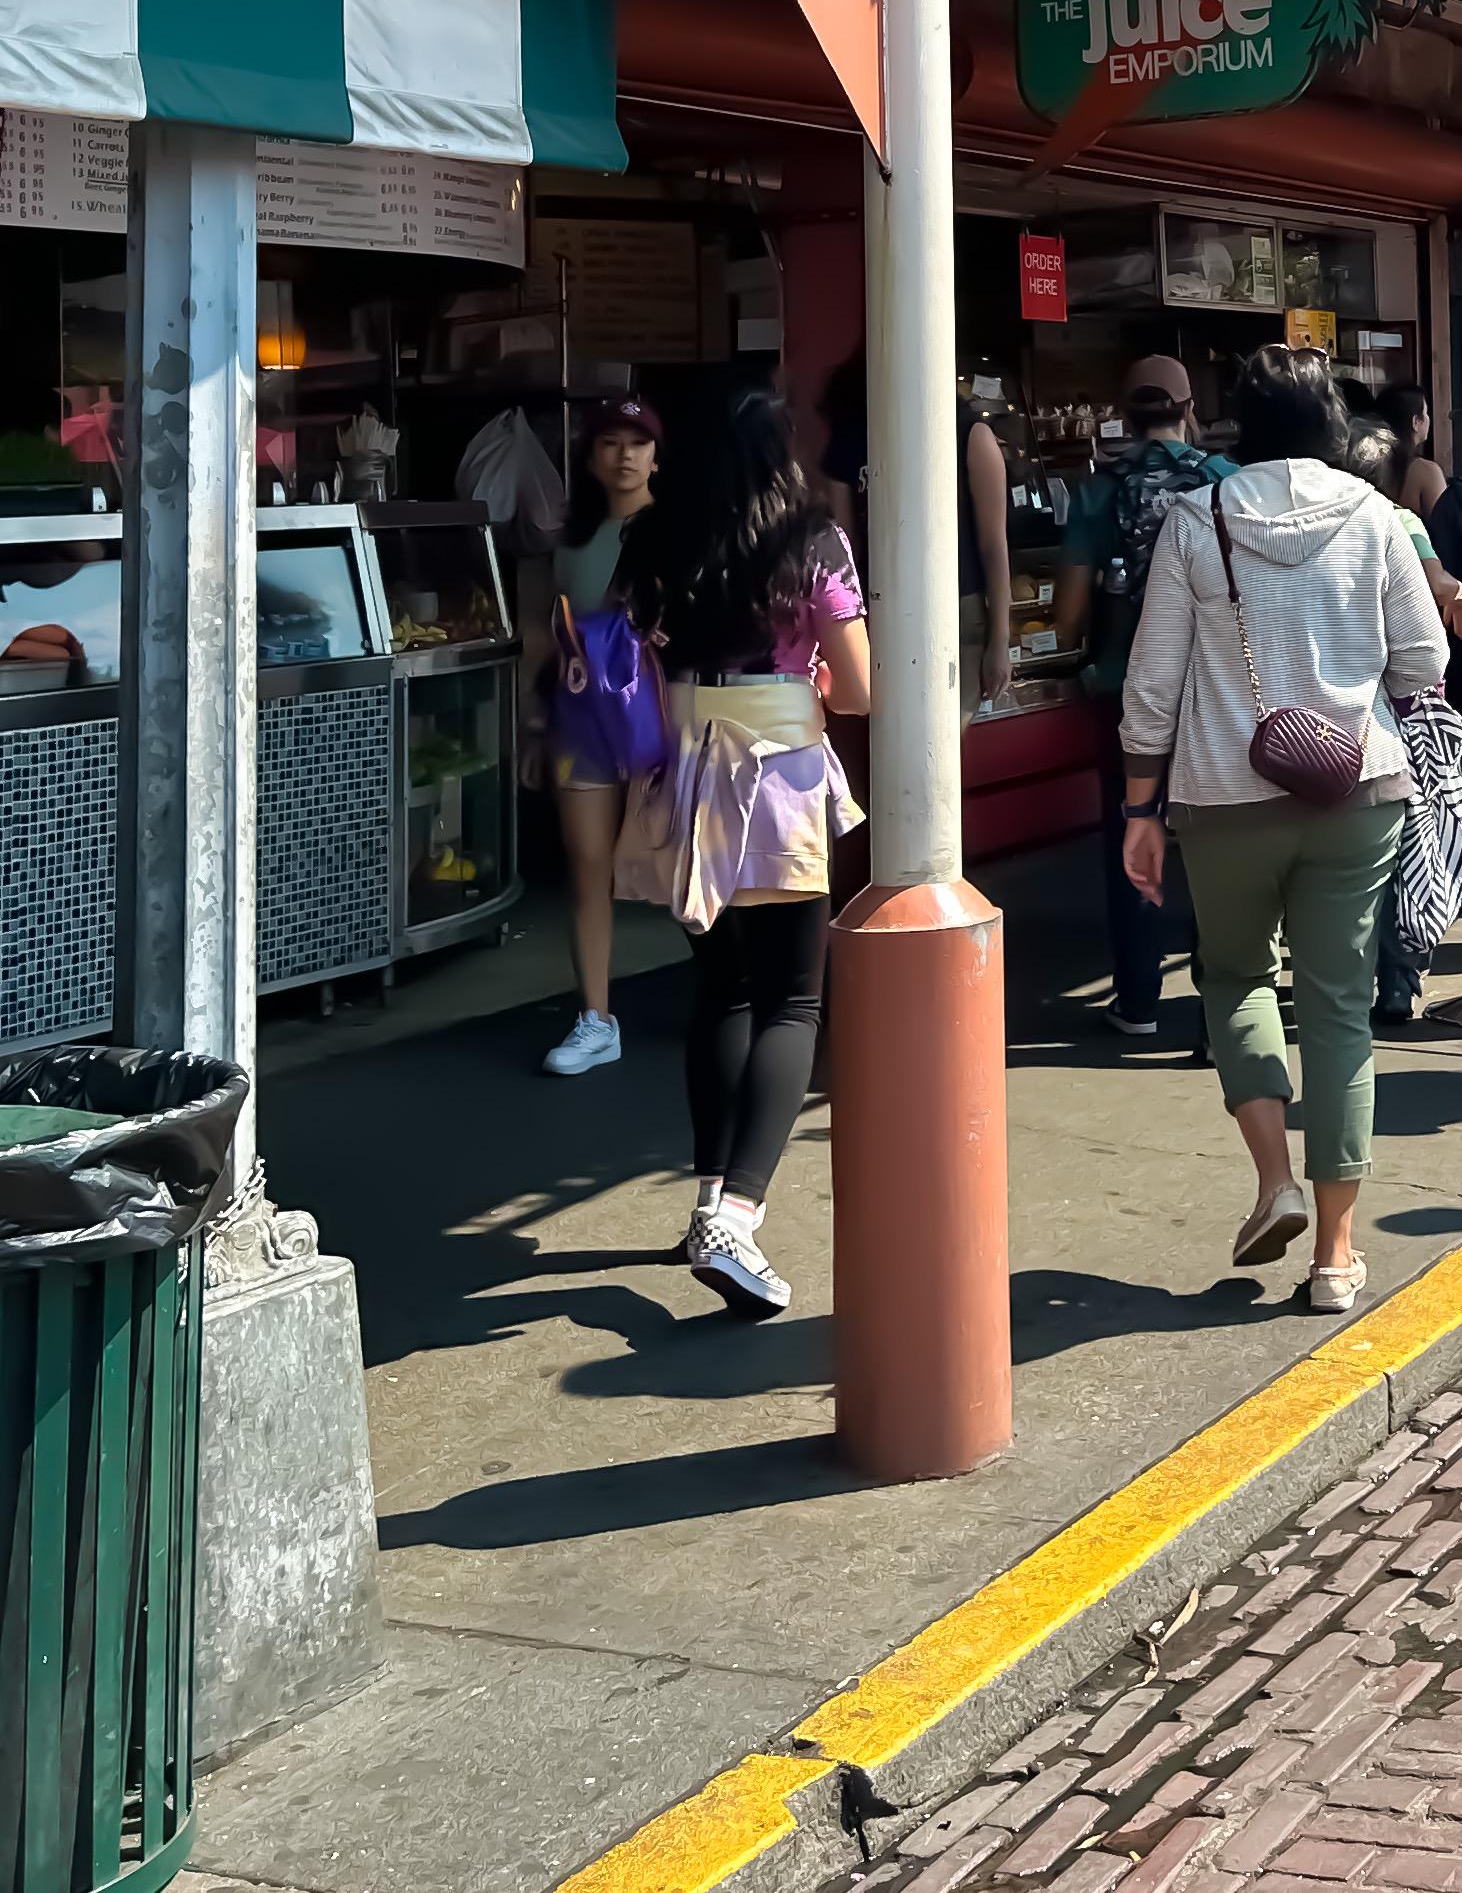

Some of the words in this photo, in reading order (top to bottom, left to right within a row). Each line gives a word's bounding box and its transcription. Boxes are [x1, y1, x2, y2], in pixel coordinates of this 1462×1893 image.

[1041, 0, 1083, 23] THE
[1109, 38, 1273, 84] EMPORIUM
[1024, 252, 1061, 271] ORDER
[1029, 277, 1058, 296] HERE
